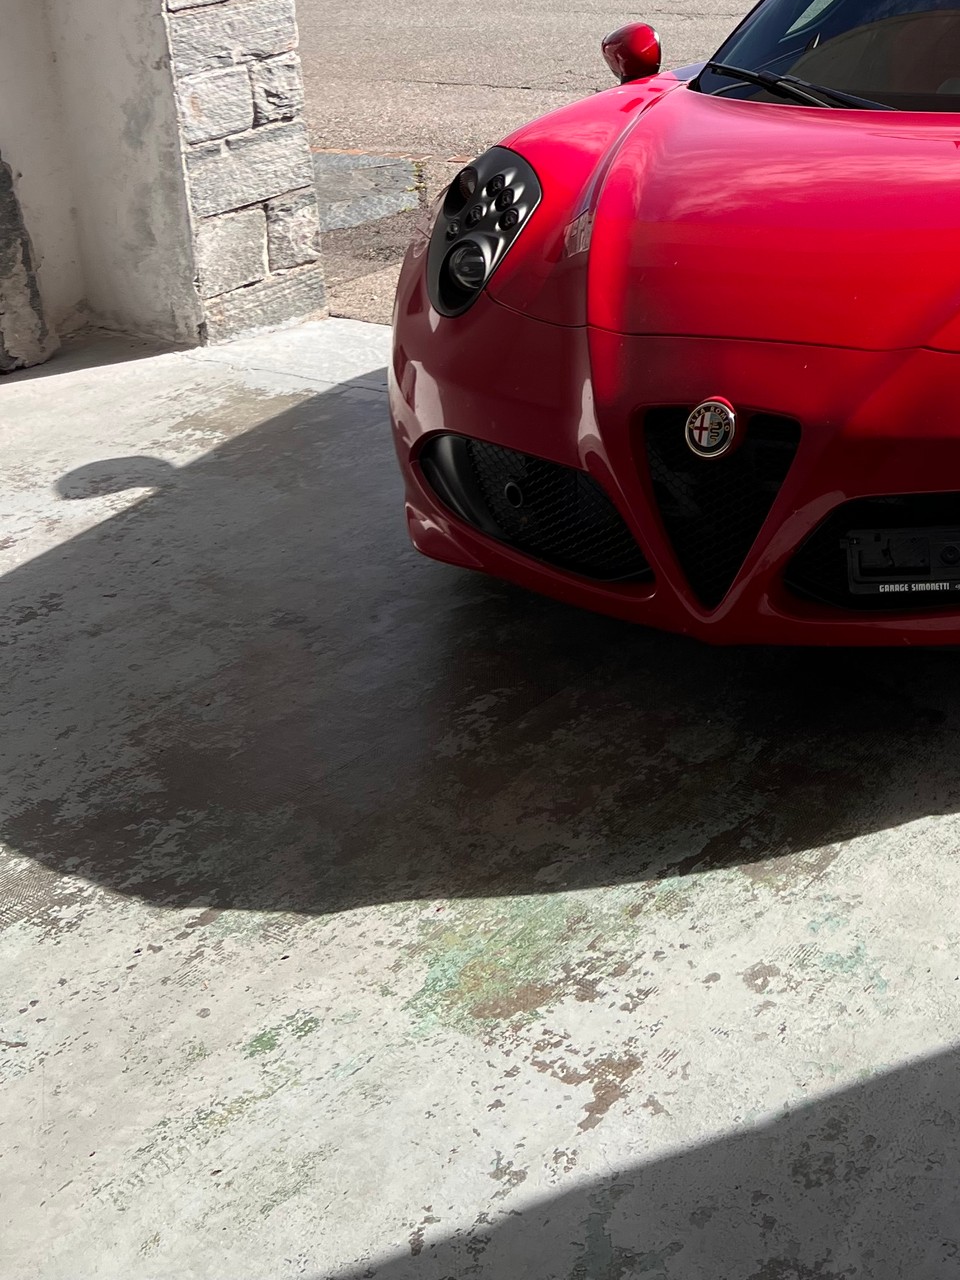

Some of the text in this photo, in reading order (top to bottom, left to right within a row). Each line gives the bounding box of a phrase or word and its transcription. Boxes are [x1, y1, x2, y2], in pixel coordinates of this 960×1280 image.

[689, 406, 730, 432] ALFA ROMEO
[880, 584, 909, 593] GARAGE
[911, 582, 950, 591] SIMONETTI
